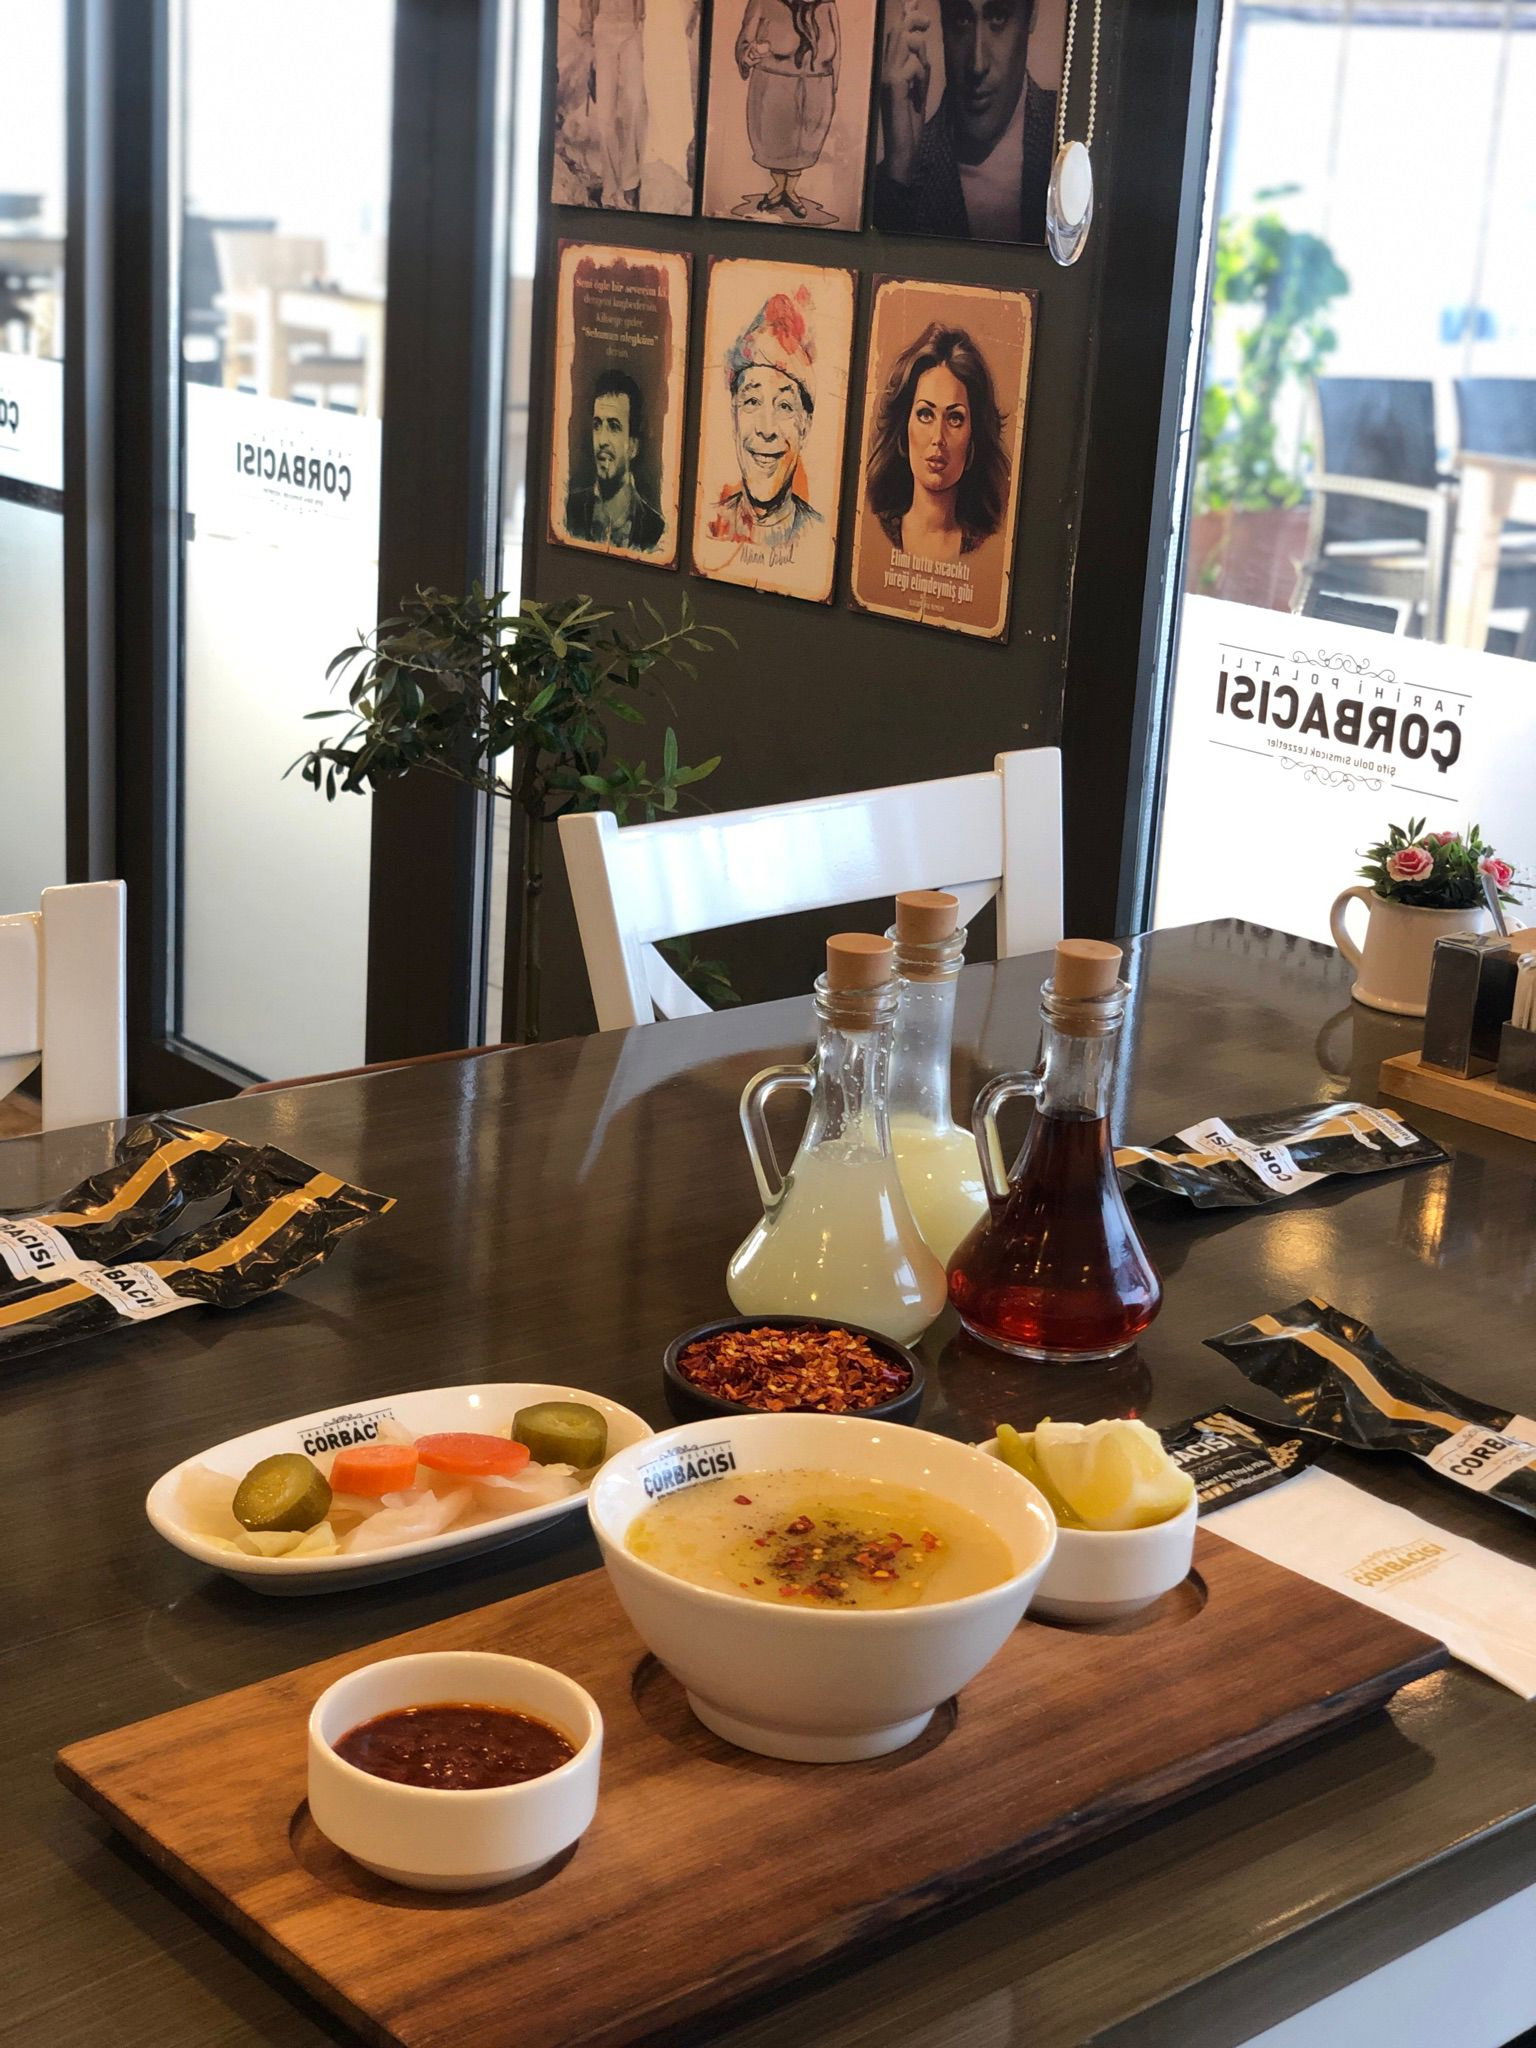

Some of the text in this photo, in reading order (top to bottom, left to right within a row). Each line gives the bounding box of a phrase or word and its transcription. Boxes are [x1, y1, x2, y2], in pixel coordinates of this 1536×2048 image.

[890, 547, 911, 569] Elimi
[957, 584, 974, 604] gibi
[643, 1451, 737, 1499] ÇORBACISI
